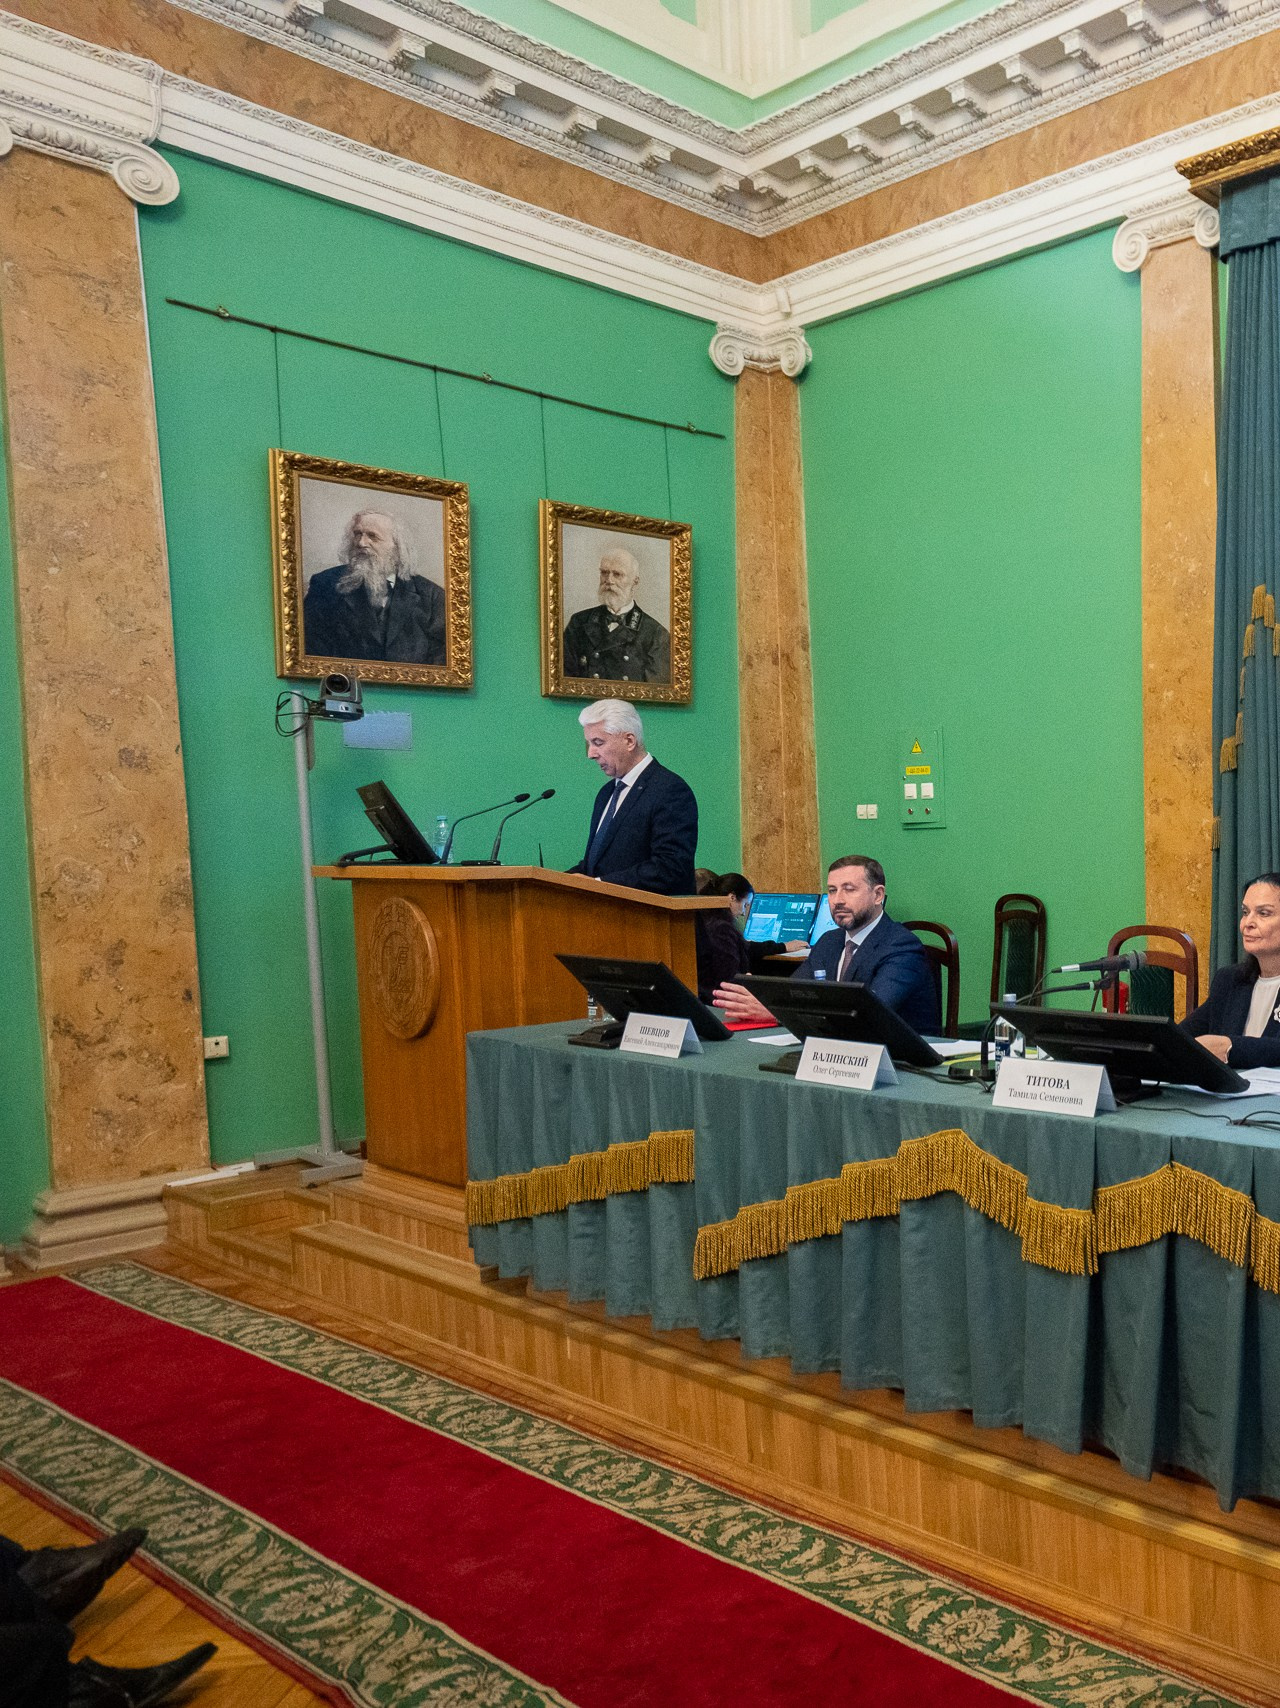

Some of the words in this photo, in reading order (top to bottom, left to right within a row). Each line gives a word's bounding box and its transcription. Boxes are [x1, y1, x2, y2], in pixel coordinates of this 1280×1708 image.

[640, 1026, 670, 1038] ШЕВЦОВ
[812, 1051, 868, 1067] ВАЛИНСКИЙ
[812, 1065, 828, 1075] Олег
[828, 1067, 861, 1080] Сергеевич
[1026, 1075, 1070, 1090] ТИТОВА
[1008, 1087, 1038, 1100] Тамила
[1039, 1091, 1083, 1106] Семеновна
